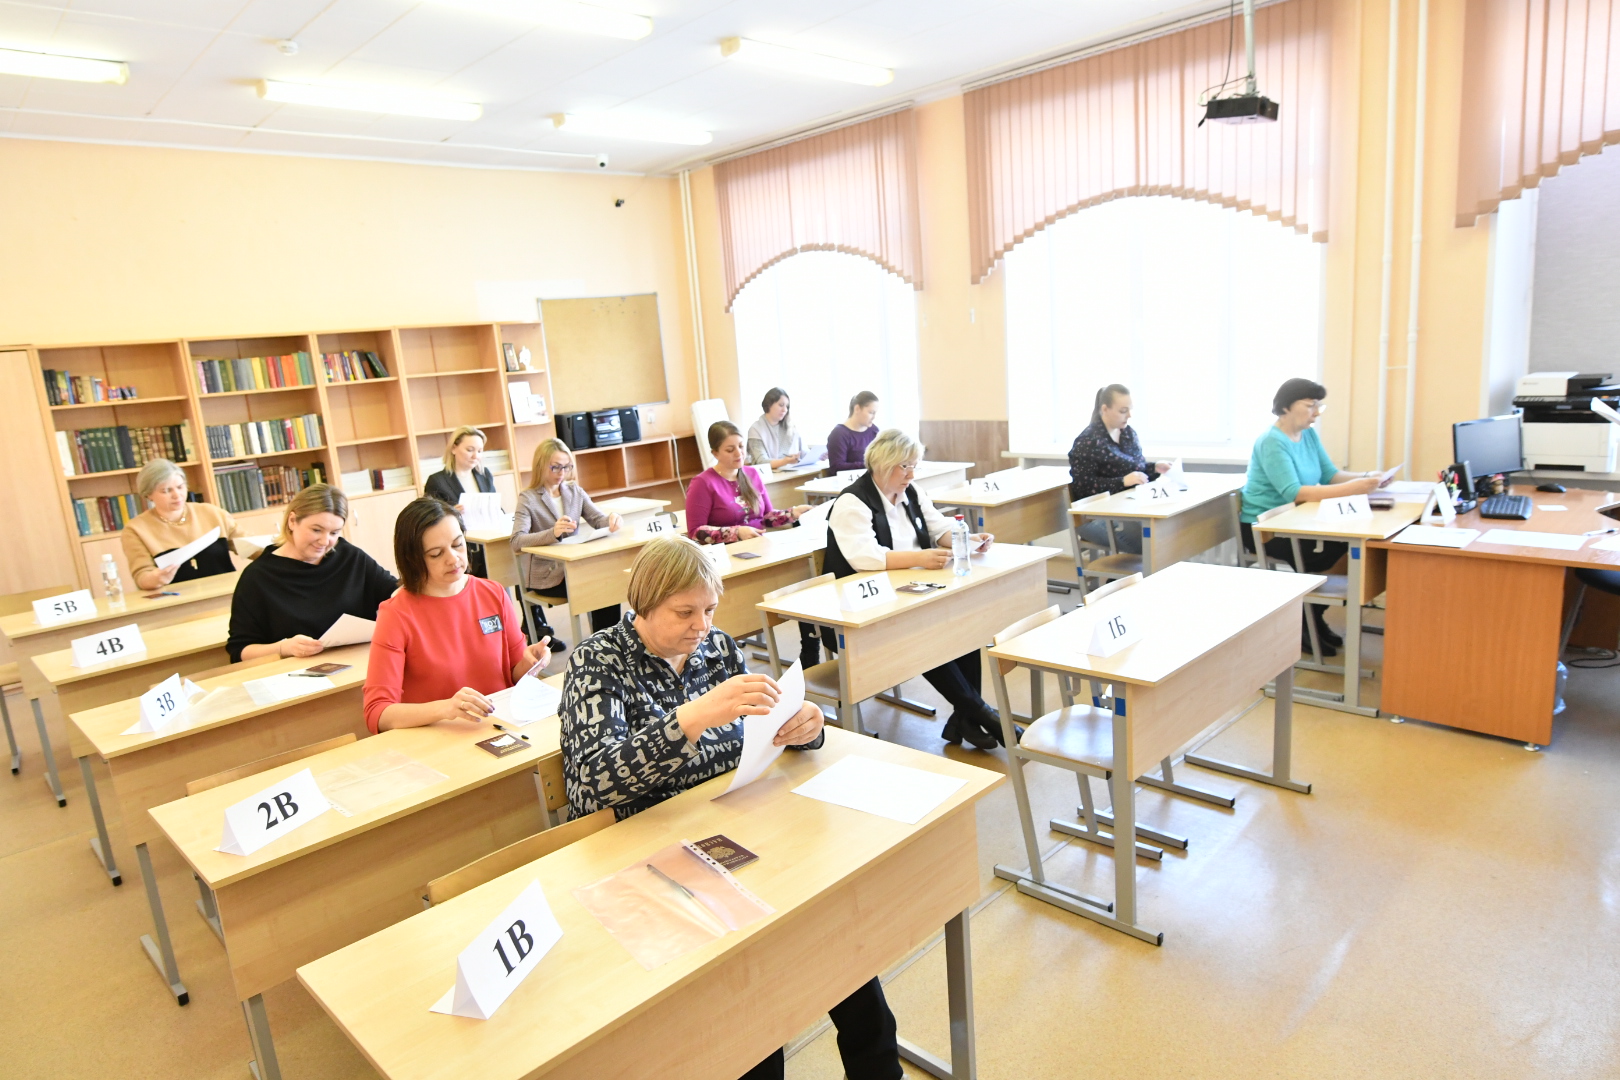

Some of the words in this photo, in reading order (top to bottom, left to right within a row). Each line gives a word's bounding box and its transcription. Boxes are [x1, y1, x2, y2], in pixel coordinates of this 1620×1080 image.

[983, 482, 1000, 493] 3А
[1150, 487, 1169, 499] 2А
[1337, 502, 1357, 515] 1А
[646, 520, 663, 533] 4Б
[858, 579, 879, 599] 2Б
[54, 600, 78, 616] 5В
[1108, 615, 1127, 640] 1Б
[96, 637, 124, 656] 4В
[156, 692, 175, 717] 3В
[257, 792, 299, 831] 2В
[493, 919, 534, 978] 1В
